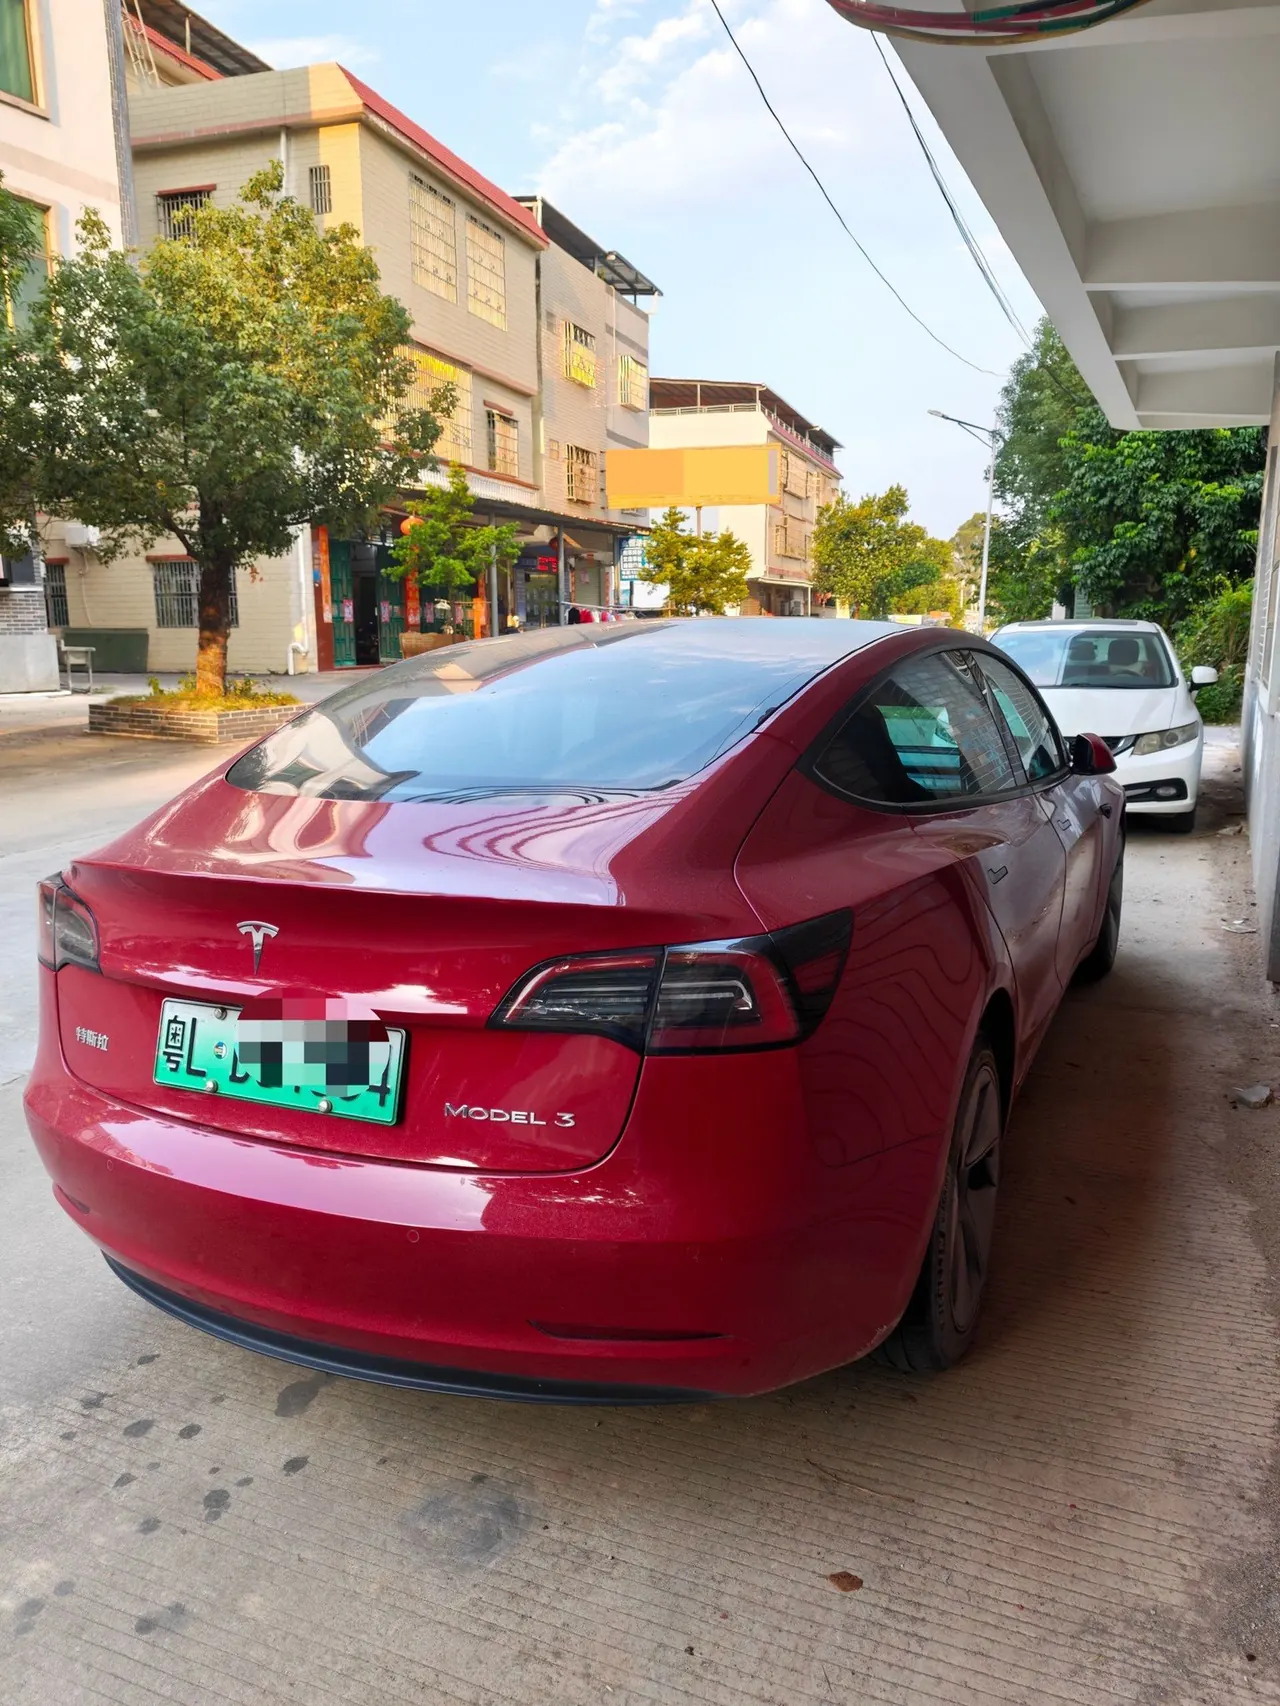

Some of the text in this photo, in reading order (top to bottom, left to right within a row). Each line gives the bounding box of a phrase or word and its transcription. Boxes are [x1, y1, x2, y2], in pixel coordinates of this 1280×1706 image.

[75, 1025, 109, 1052] 特斯拉
[443, 1102, 576, 1127] MODEL 3
